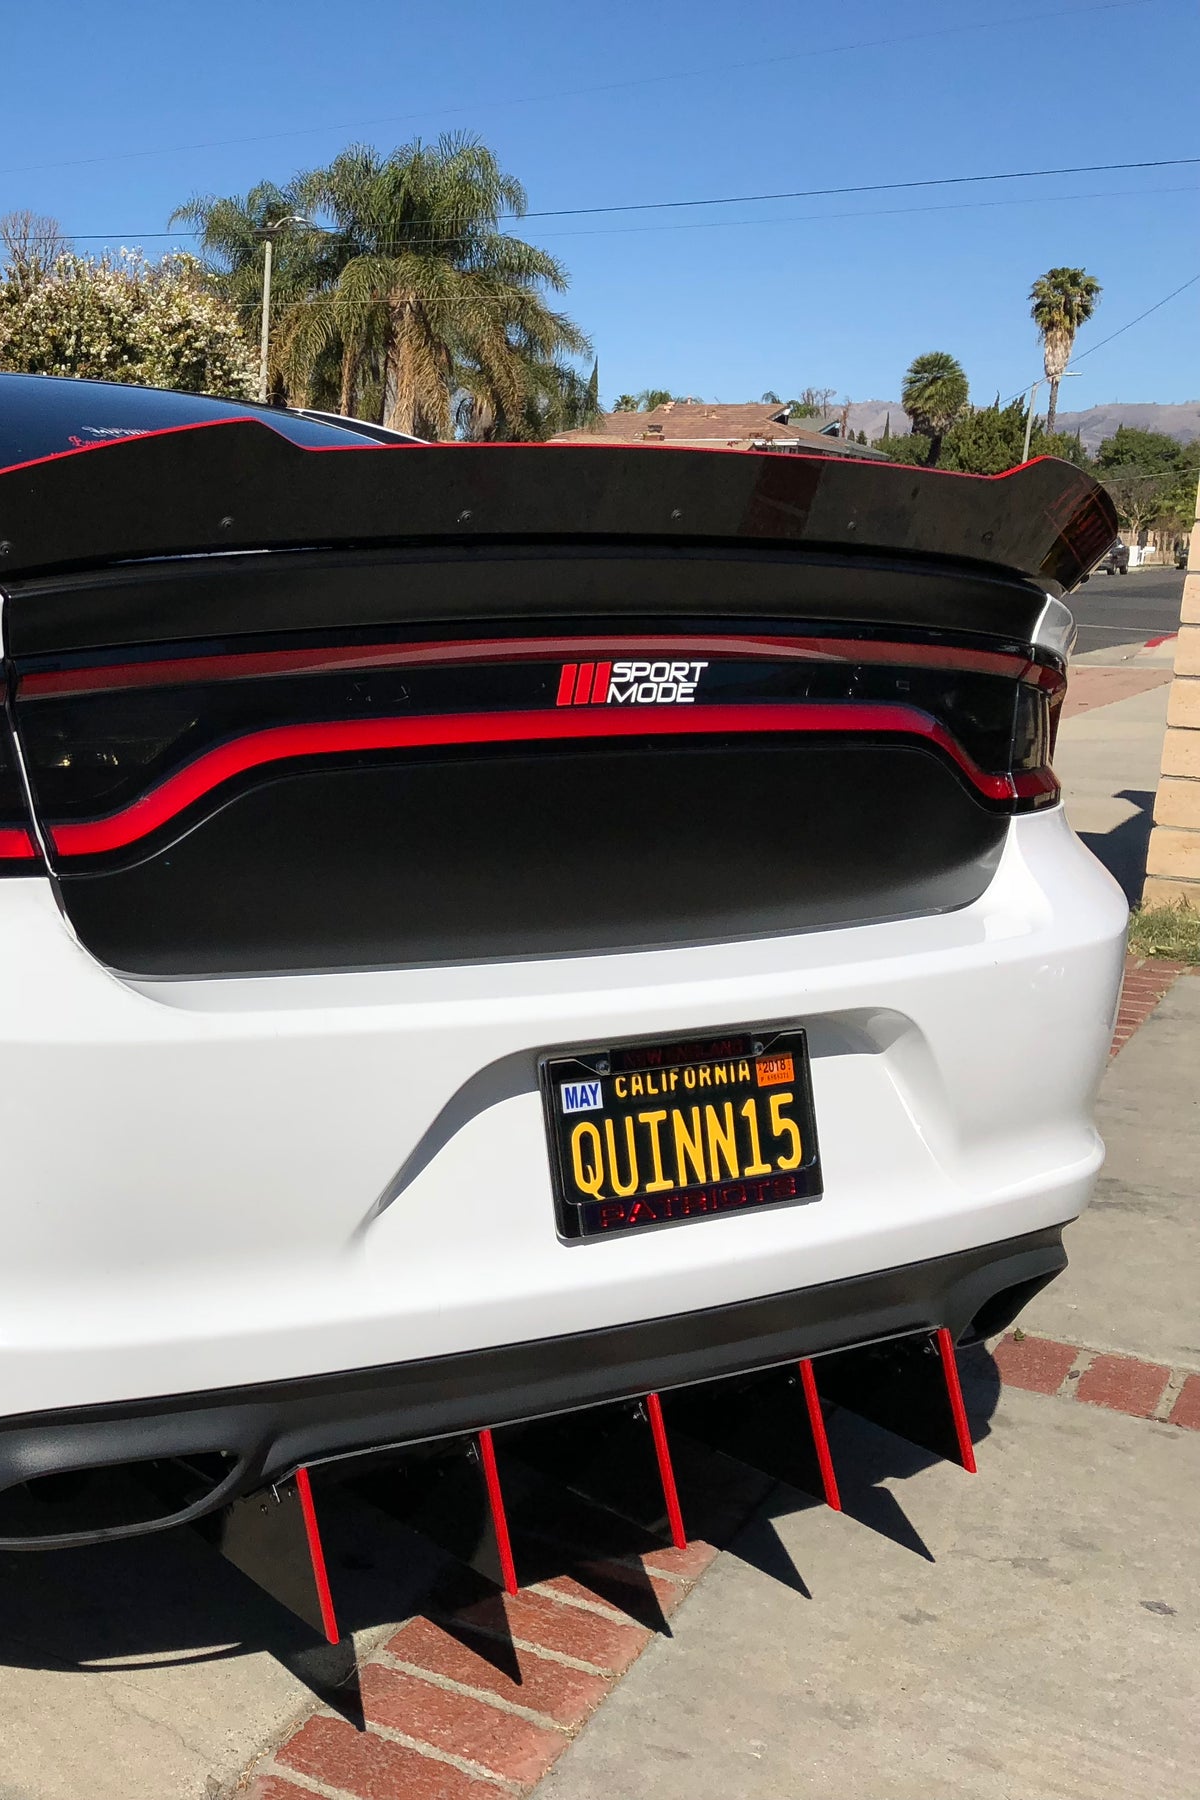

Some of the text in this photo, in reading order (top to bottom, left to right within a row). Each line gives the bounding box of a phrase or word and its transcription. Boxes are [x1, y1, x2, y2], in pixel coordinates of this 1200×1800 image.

[611, 662, 708, 682] SPORT
[607, 682, 697, 703] MODE
[615, 1059, 750, 1098] CALIFORNIA
[762, 1058, 786, 1073] 2018
[564, 1083, 599, 1109] MAY
[571, 1092, 802, 1200] QUINN15
[601, 1176, 796, 1227] PATRIOTS
